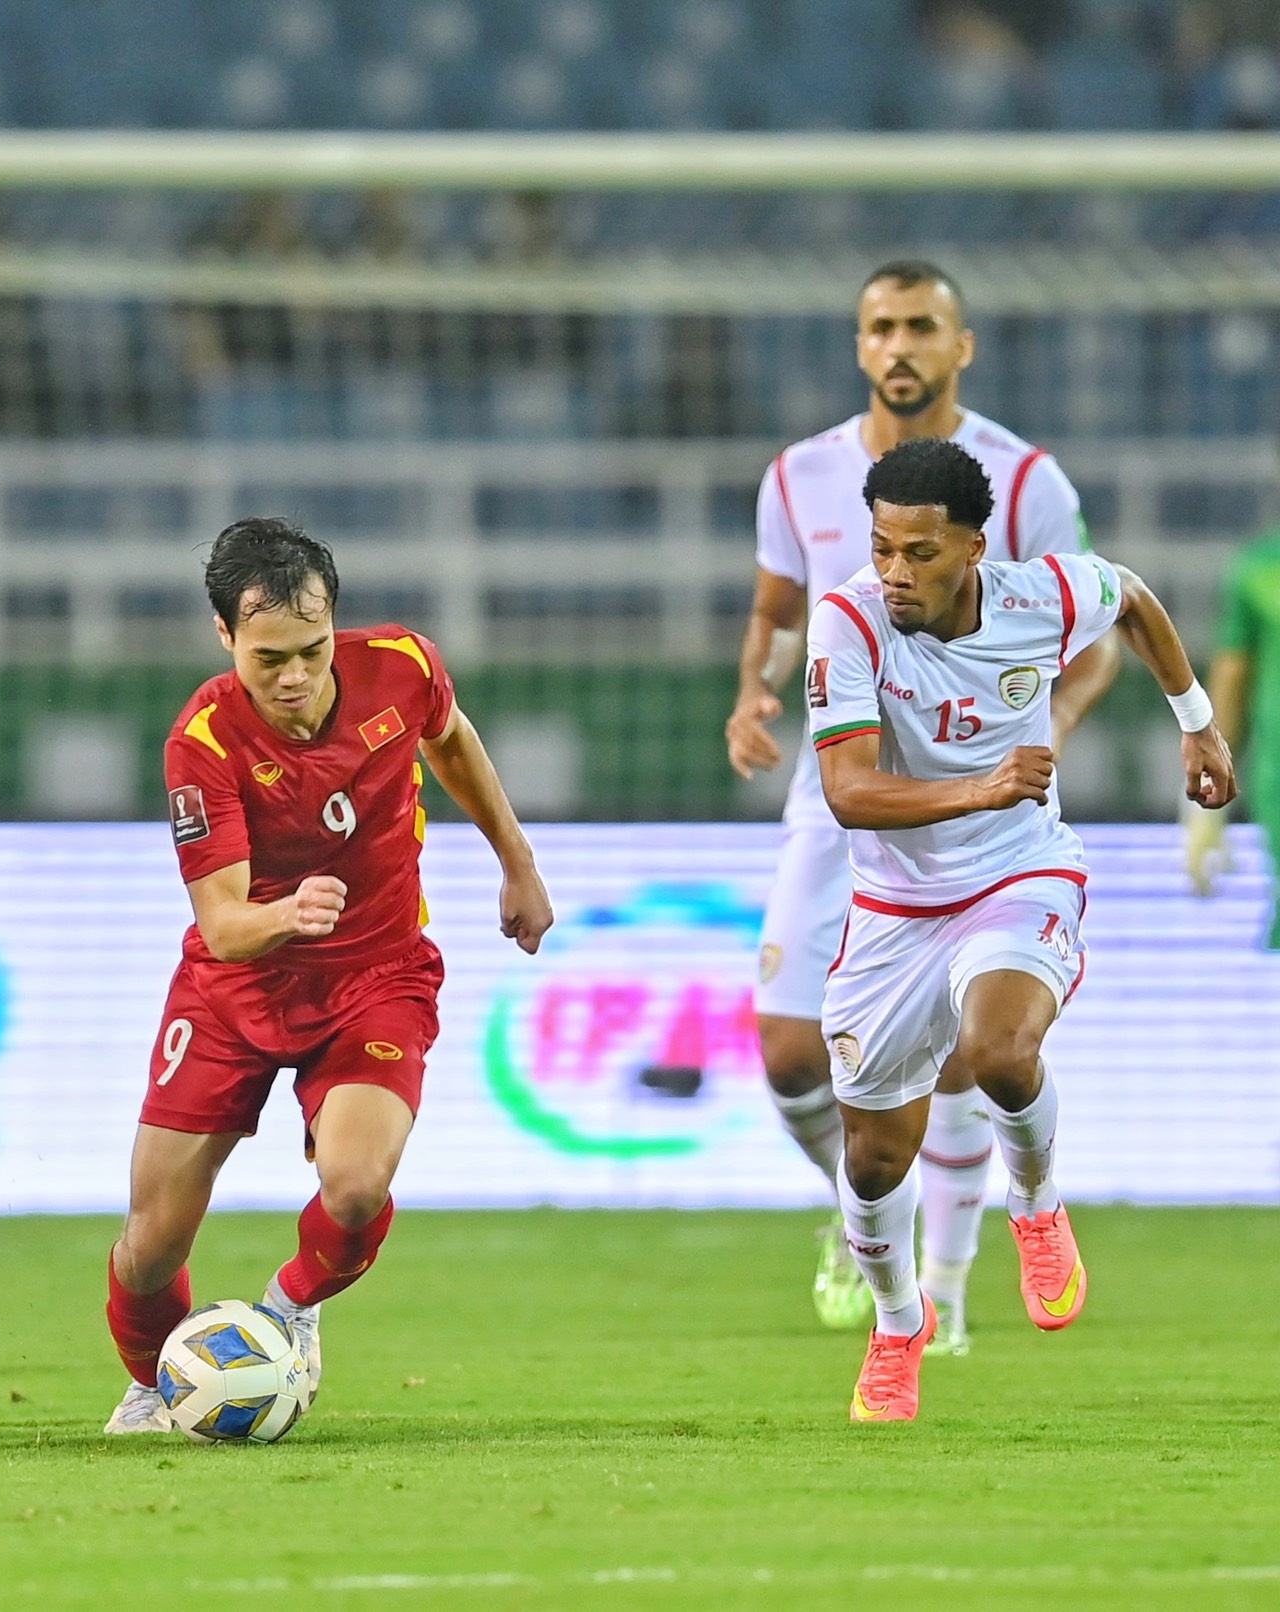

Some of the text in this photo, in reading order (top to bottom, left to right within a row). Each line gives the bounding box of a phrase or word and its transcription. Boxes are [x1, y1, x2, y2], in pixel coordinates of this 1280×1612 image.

[932, 697, 982, 743] 15
[322, 791, 357, 841] 9
[157, 1018, 193, 1086] 9
